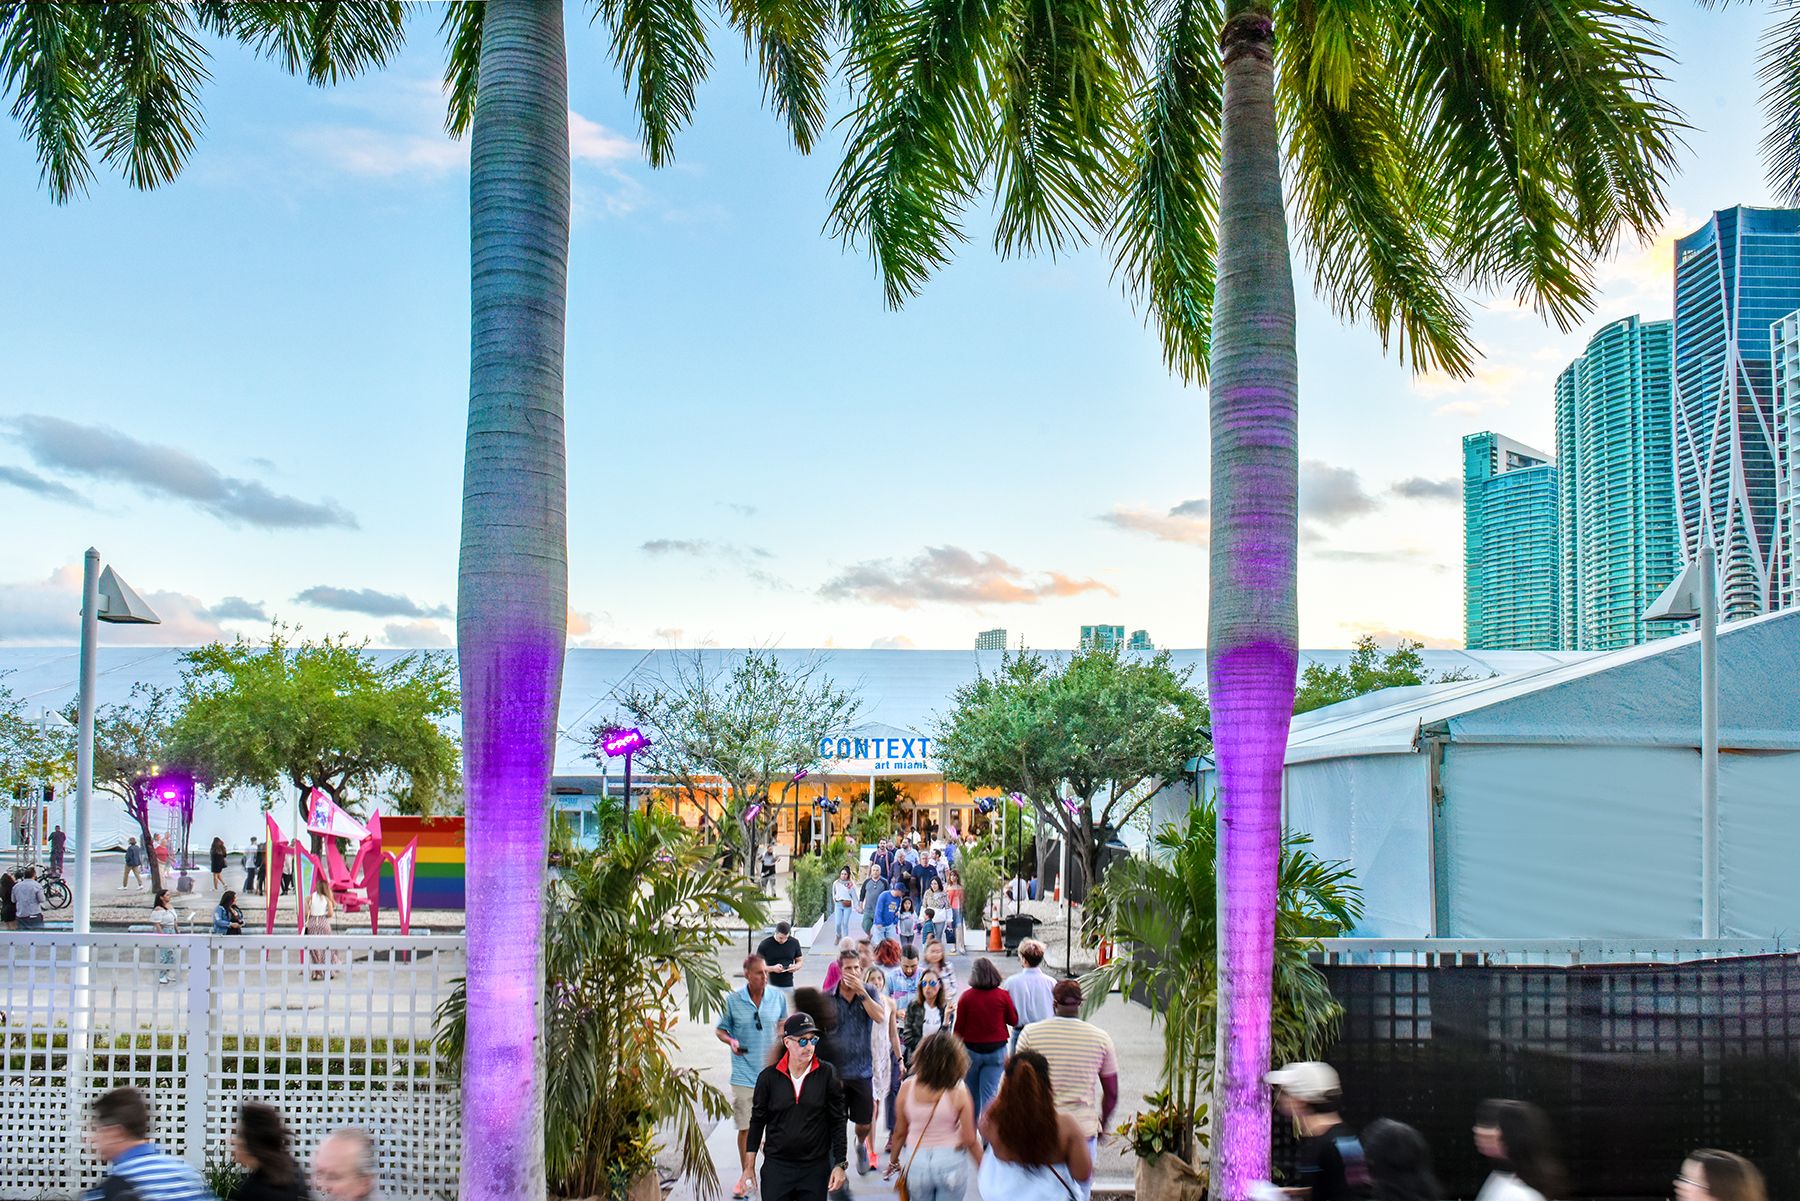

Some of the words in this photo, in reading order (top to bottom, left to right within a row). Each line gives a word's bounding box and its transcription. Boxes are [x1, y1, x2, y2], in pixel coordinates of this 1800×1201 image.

[820, 737, 931, 759] CONTEXT
[875, 761, 890, 770] art
[894, 760, 928, 770] miami
